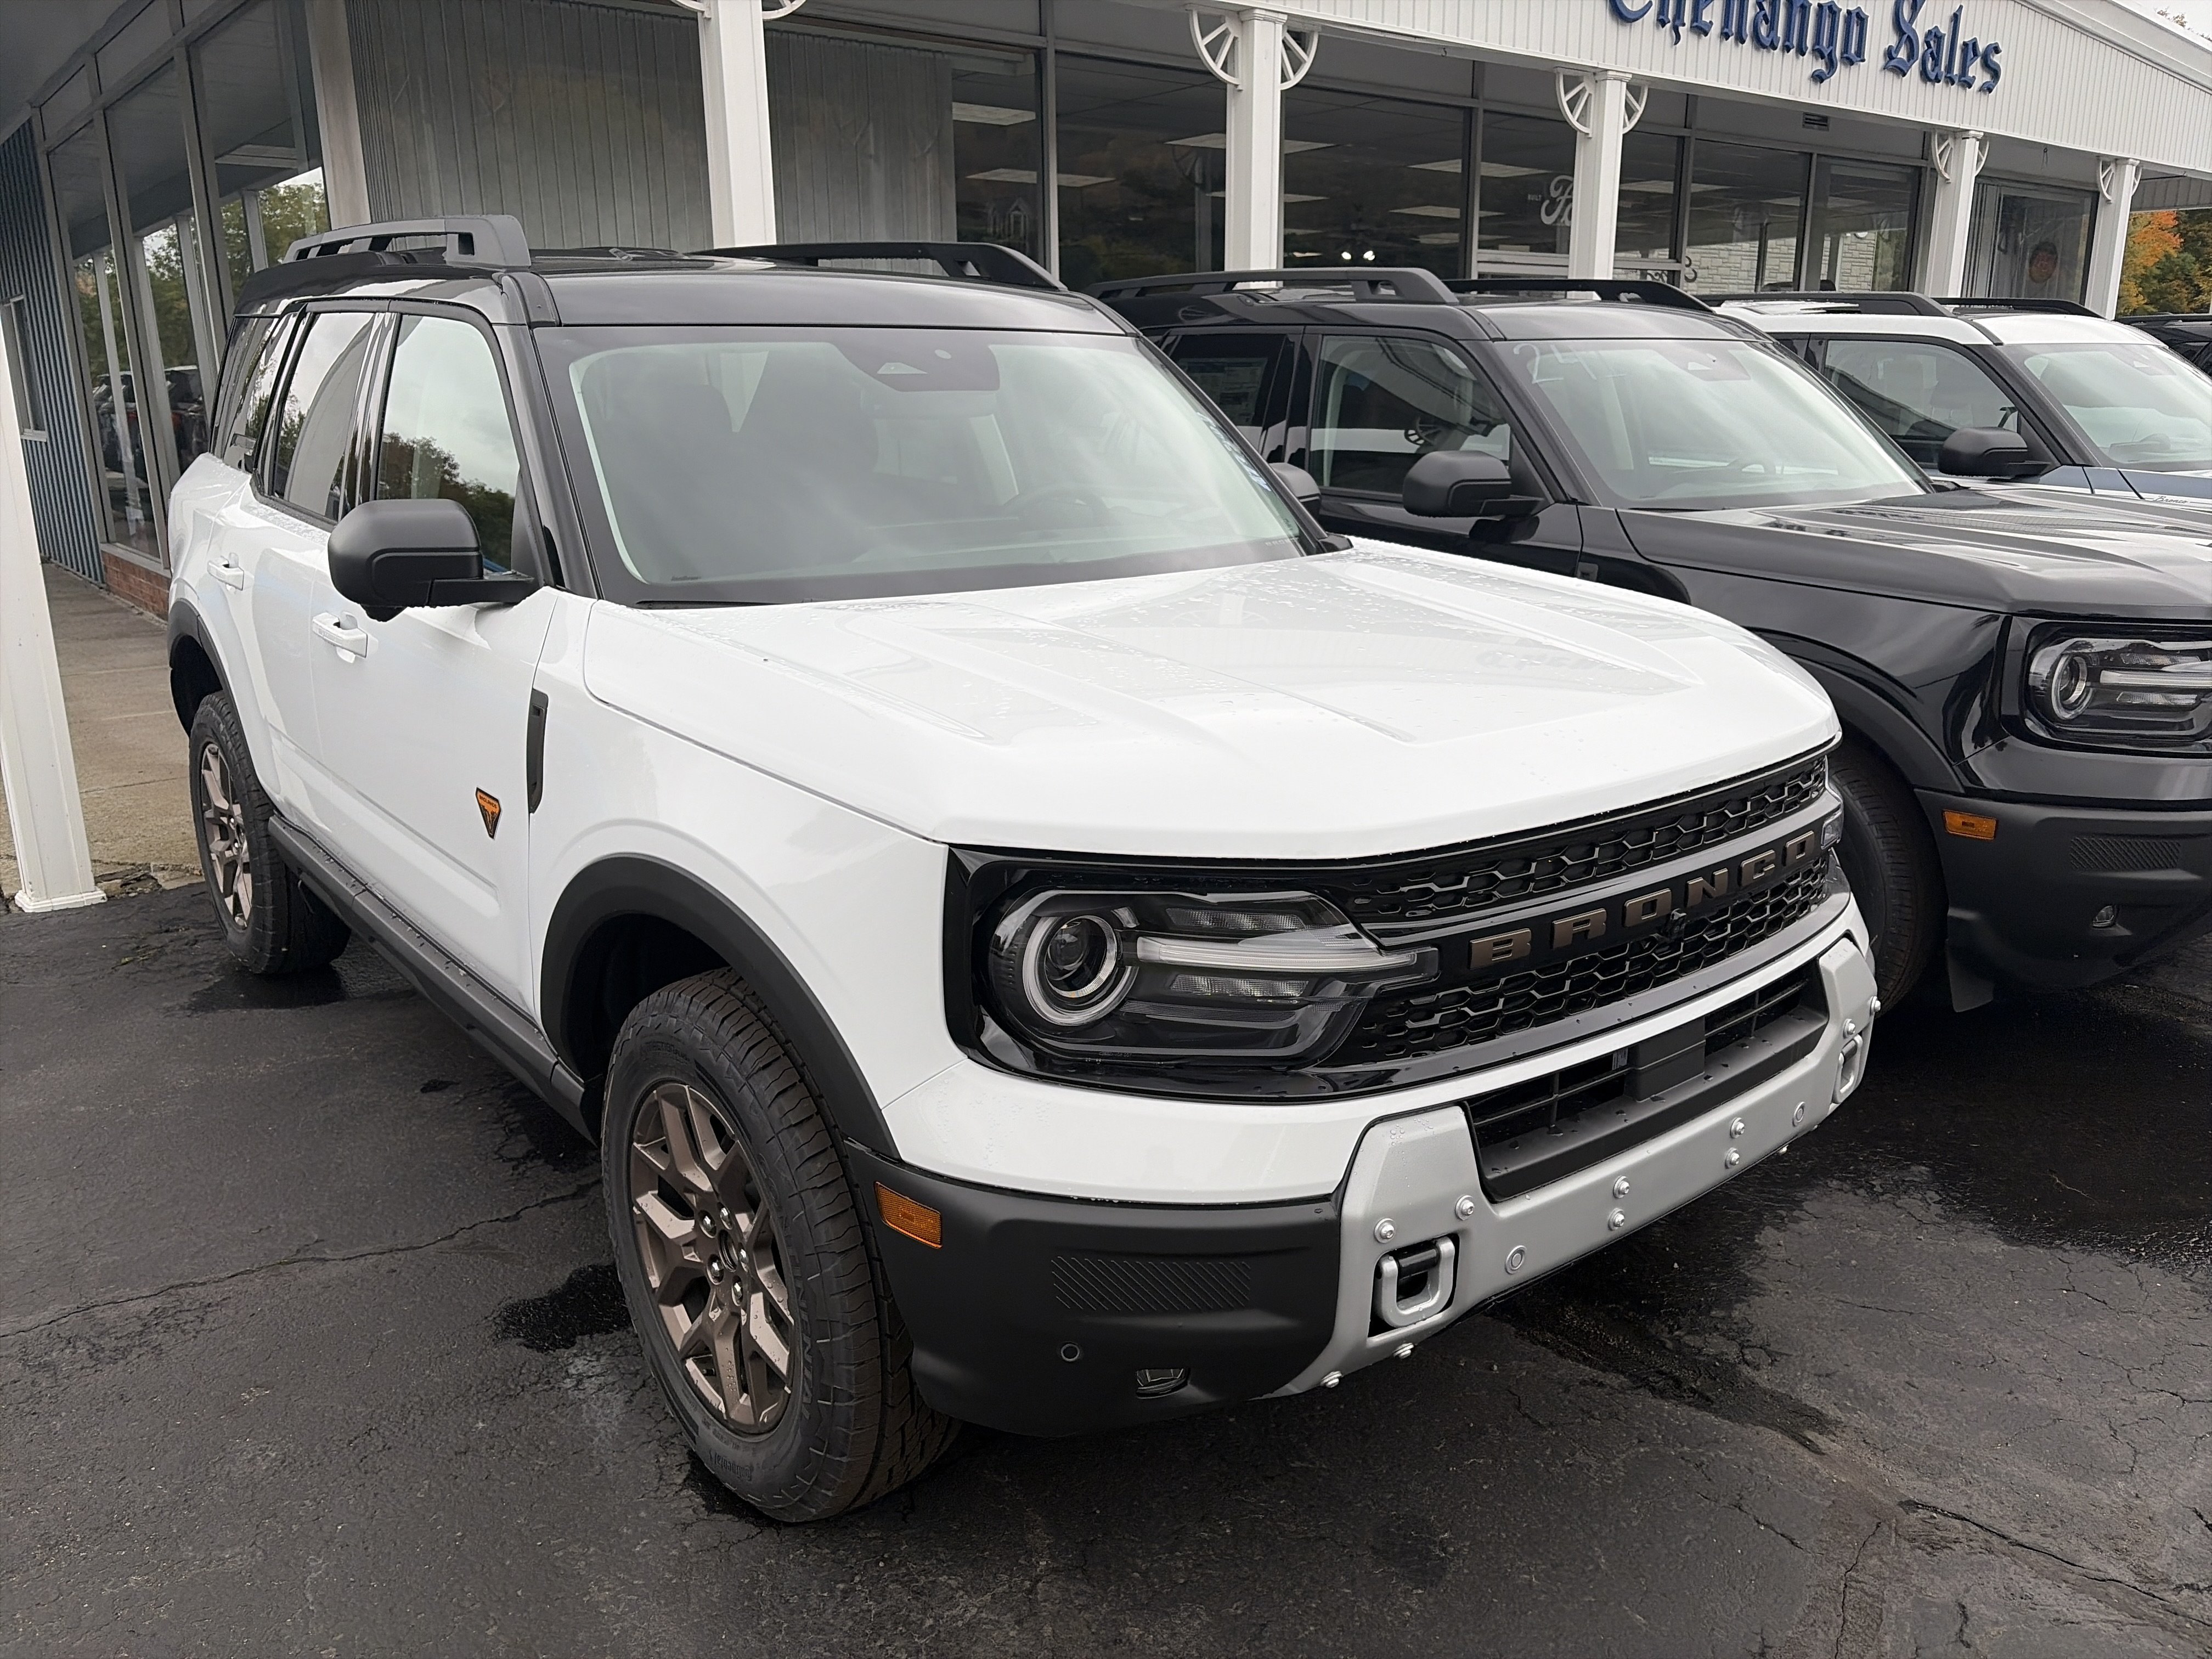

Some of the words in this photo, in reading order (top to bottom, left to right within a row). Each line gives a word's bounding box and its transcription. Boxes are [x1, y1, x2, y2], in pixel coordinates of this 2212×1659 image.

[1883, 0, 2002, 94] Sales
[2153, 495, 2188, 504] Bronco
[1469, 830, 1815, 970] BRONCO
